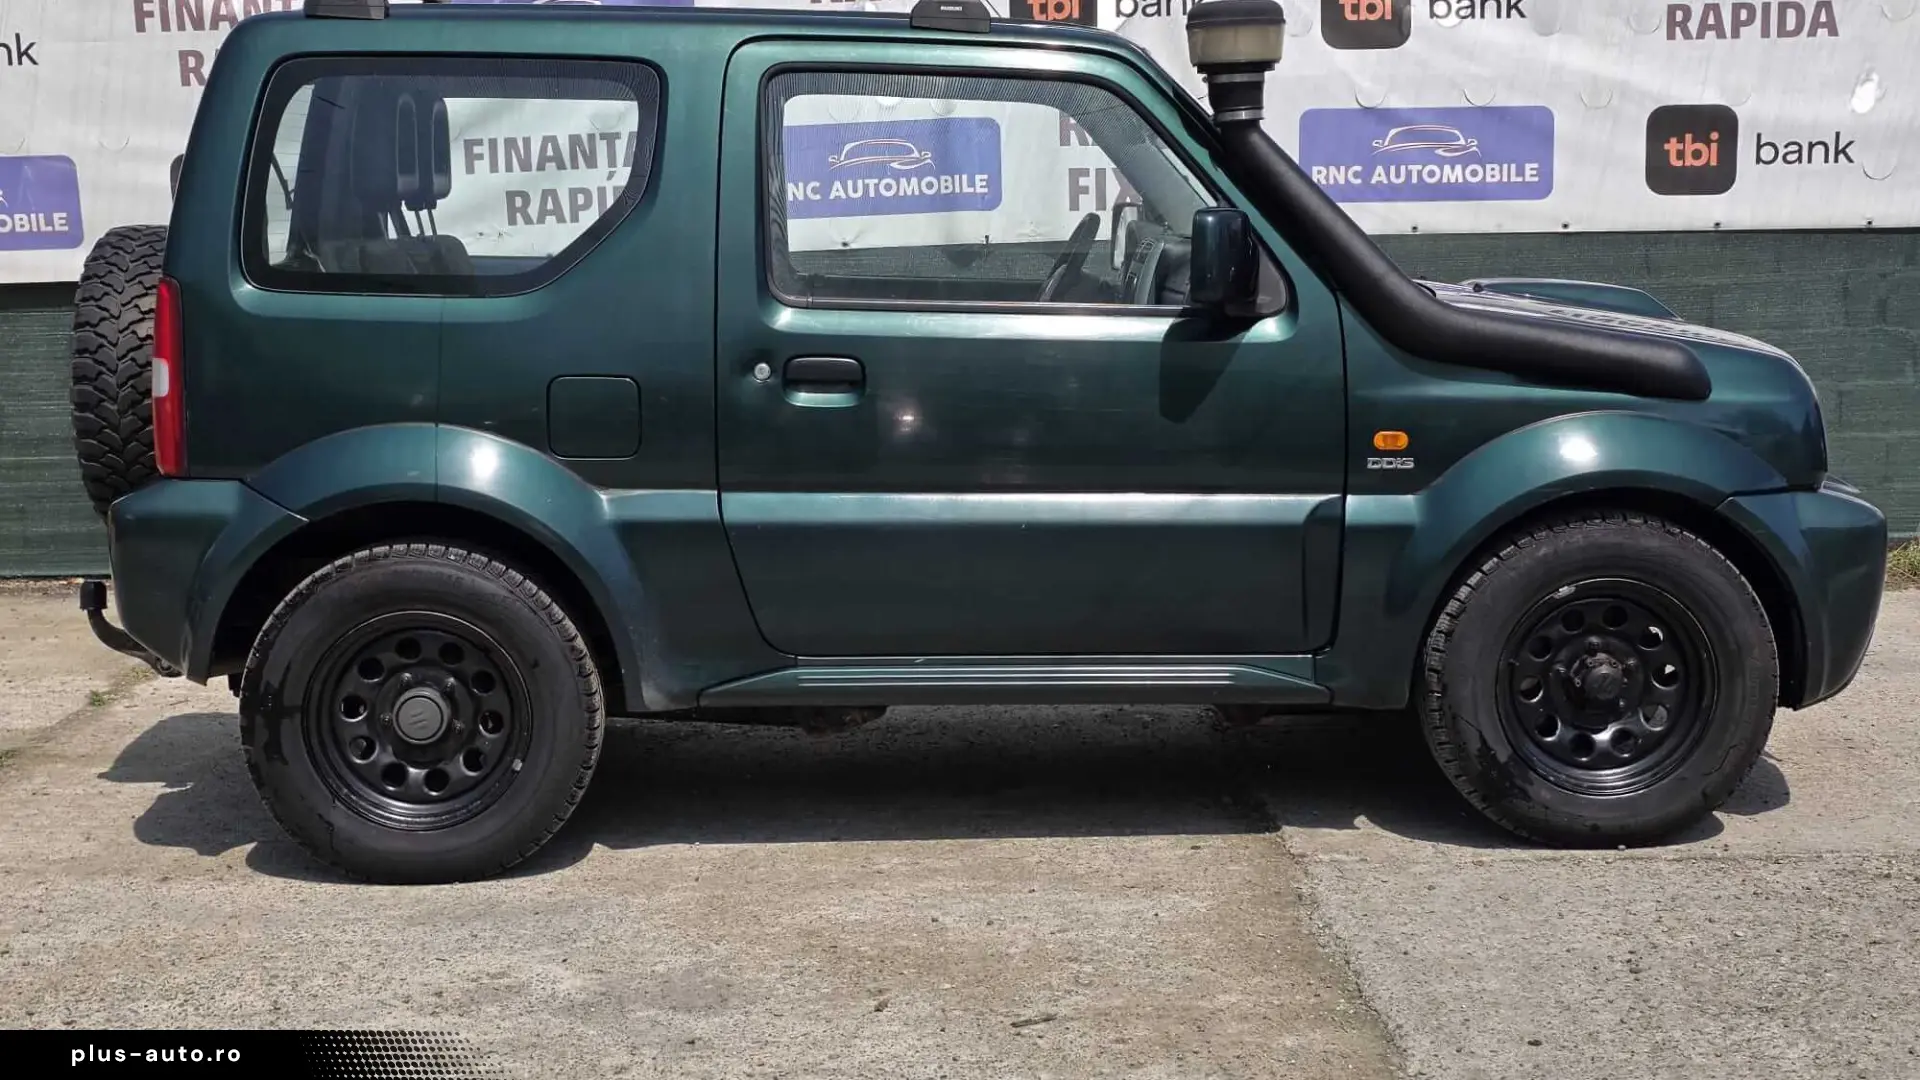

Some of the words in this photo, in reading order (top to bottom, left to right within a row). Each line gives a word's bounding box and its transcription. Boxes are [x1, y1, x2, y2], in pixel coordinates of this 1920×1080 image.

[1116, 0, 1202, 18] ban
[1429, 0, 1527, 20] bank
[1666, 0, 1839, 40] RAPIDA
[1664, 131, 1719, 167] tbi
[1755, 131, 1855, 165] bank
[1311, 165, 1363, 185] RNC
[1370, 163, 1539, 184] AUTOMOBILE
[787, 181, 821, 201] NC
[829, 174, 989, 199] AUTOMOBILE
